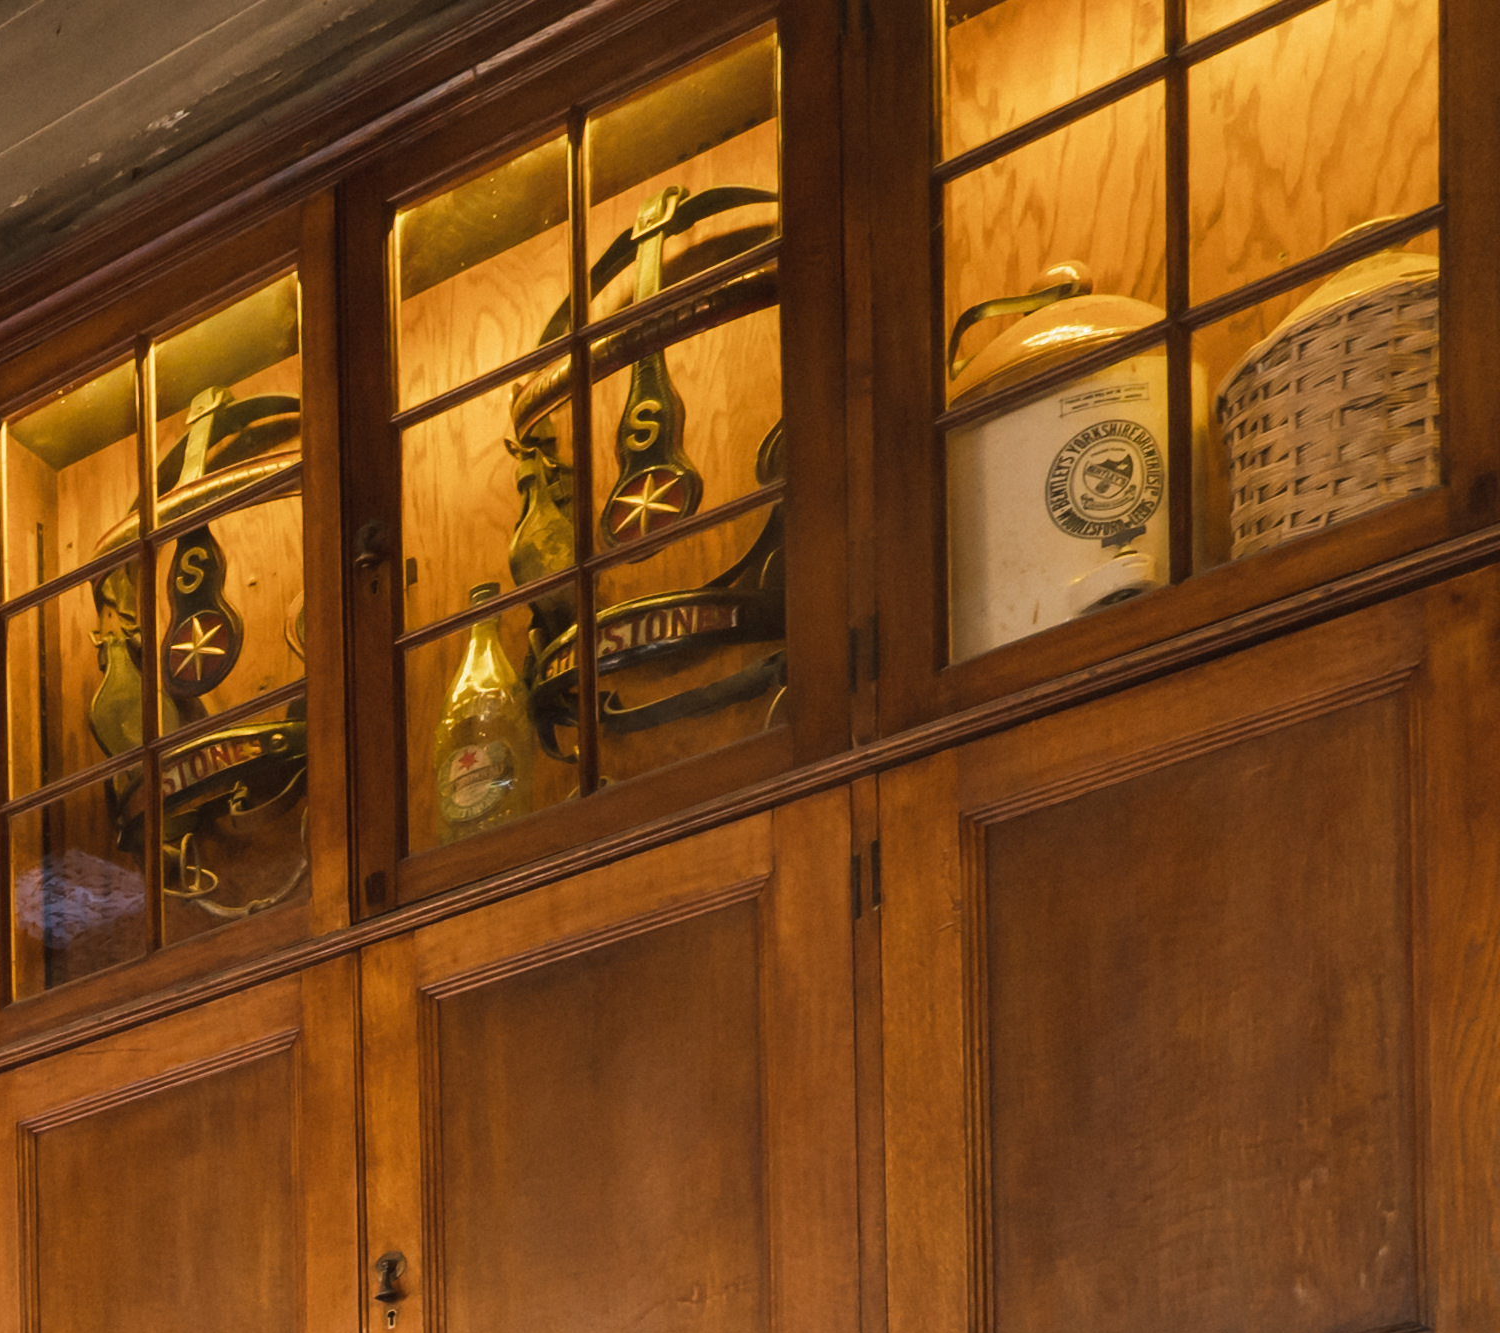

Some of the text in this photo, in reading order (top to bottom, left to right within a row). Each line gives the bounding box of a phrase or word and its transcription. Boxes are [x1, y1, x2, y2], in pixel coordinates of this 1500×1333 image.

[626, 398, 667, 453] S
[1065, 422, 1141, 455] YORKSHIRE
[174, 544, 211, 597] S
